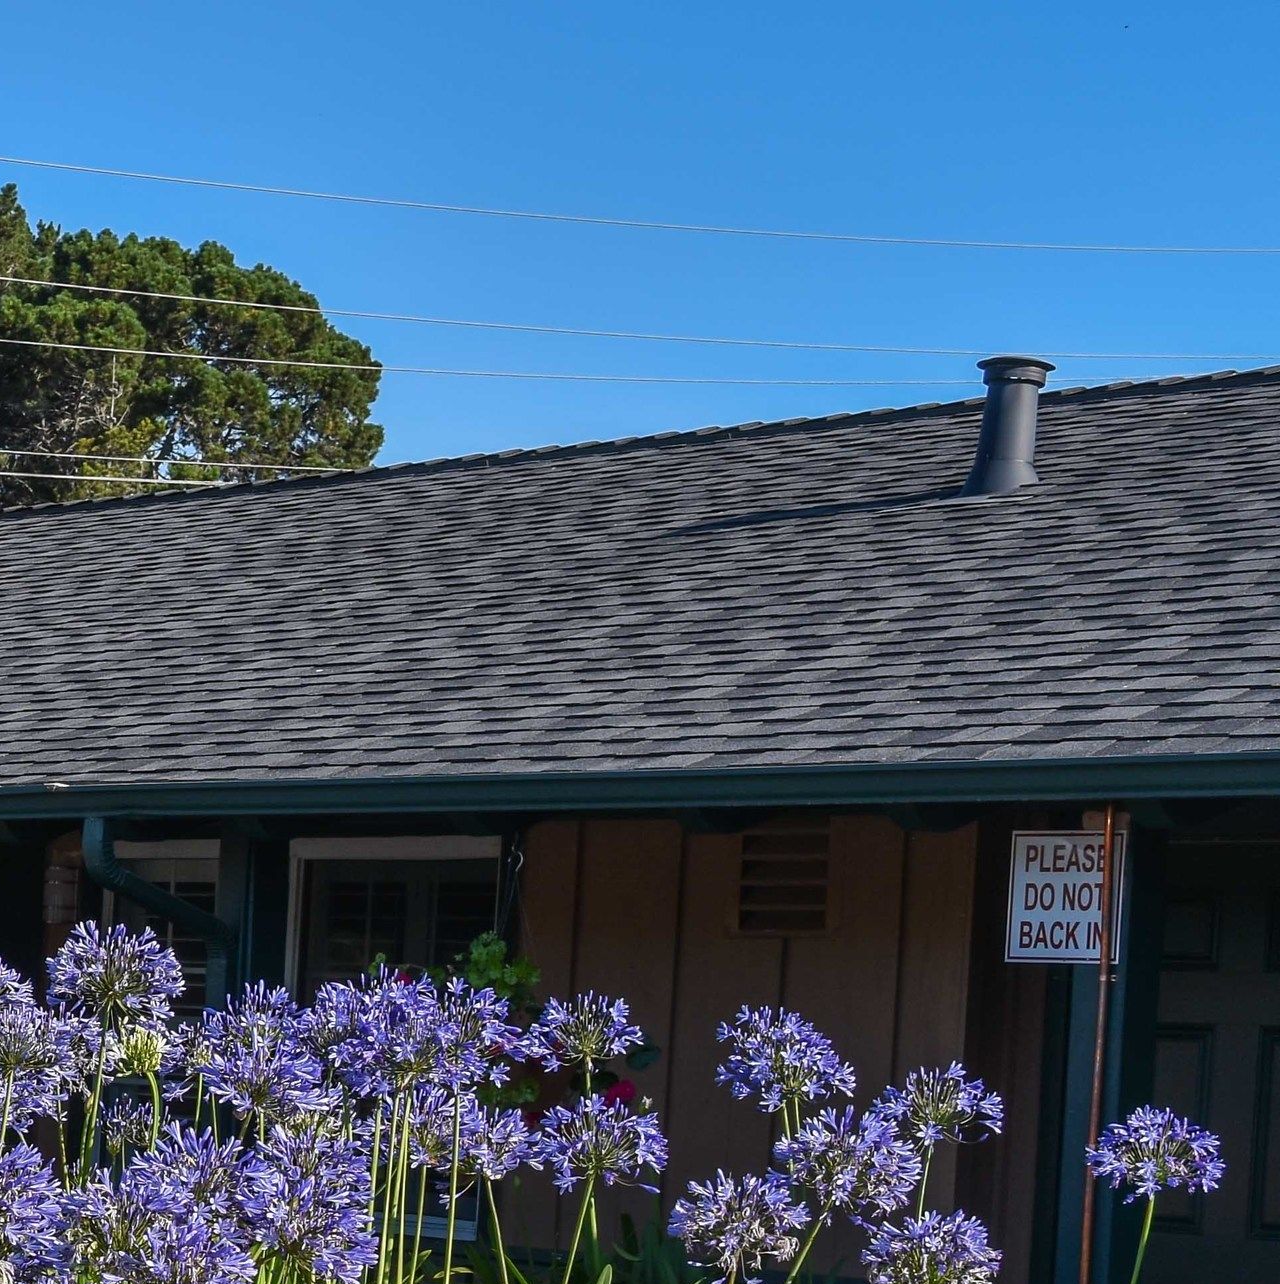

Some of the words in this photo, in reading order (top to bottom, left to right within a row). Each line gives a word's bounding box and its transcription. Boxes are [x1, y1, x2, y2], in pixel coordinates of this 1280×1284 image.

[1025, 844, 1105, 873] PLEASE
[1024, 883, 1055, 911] DO
[1019, 921, 1080, 949] BACK
